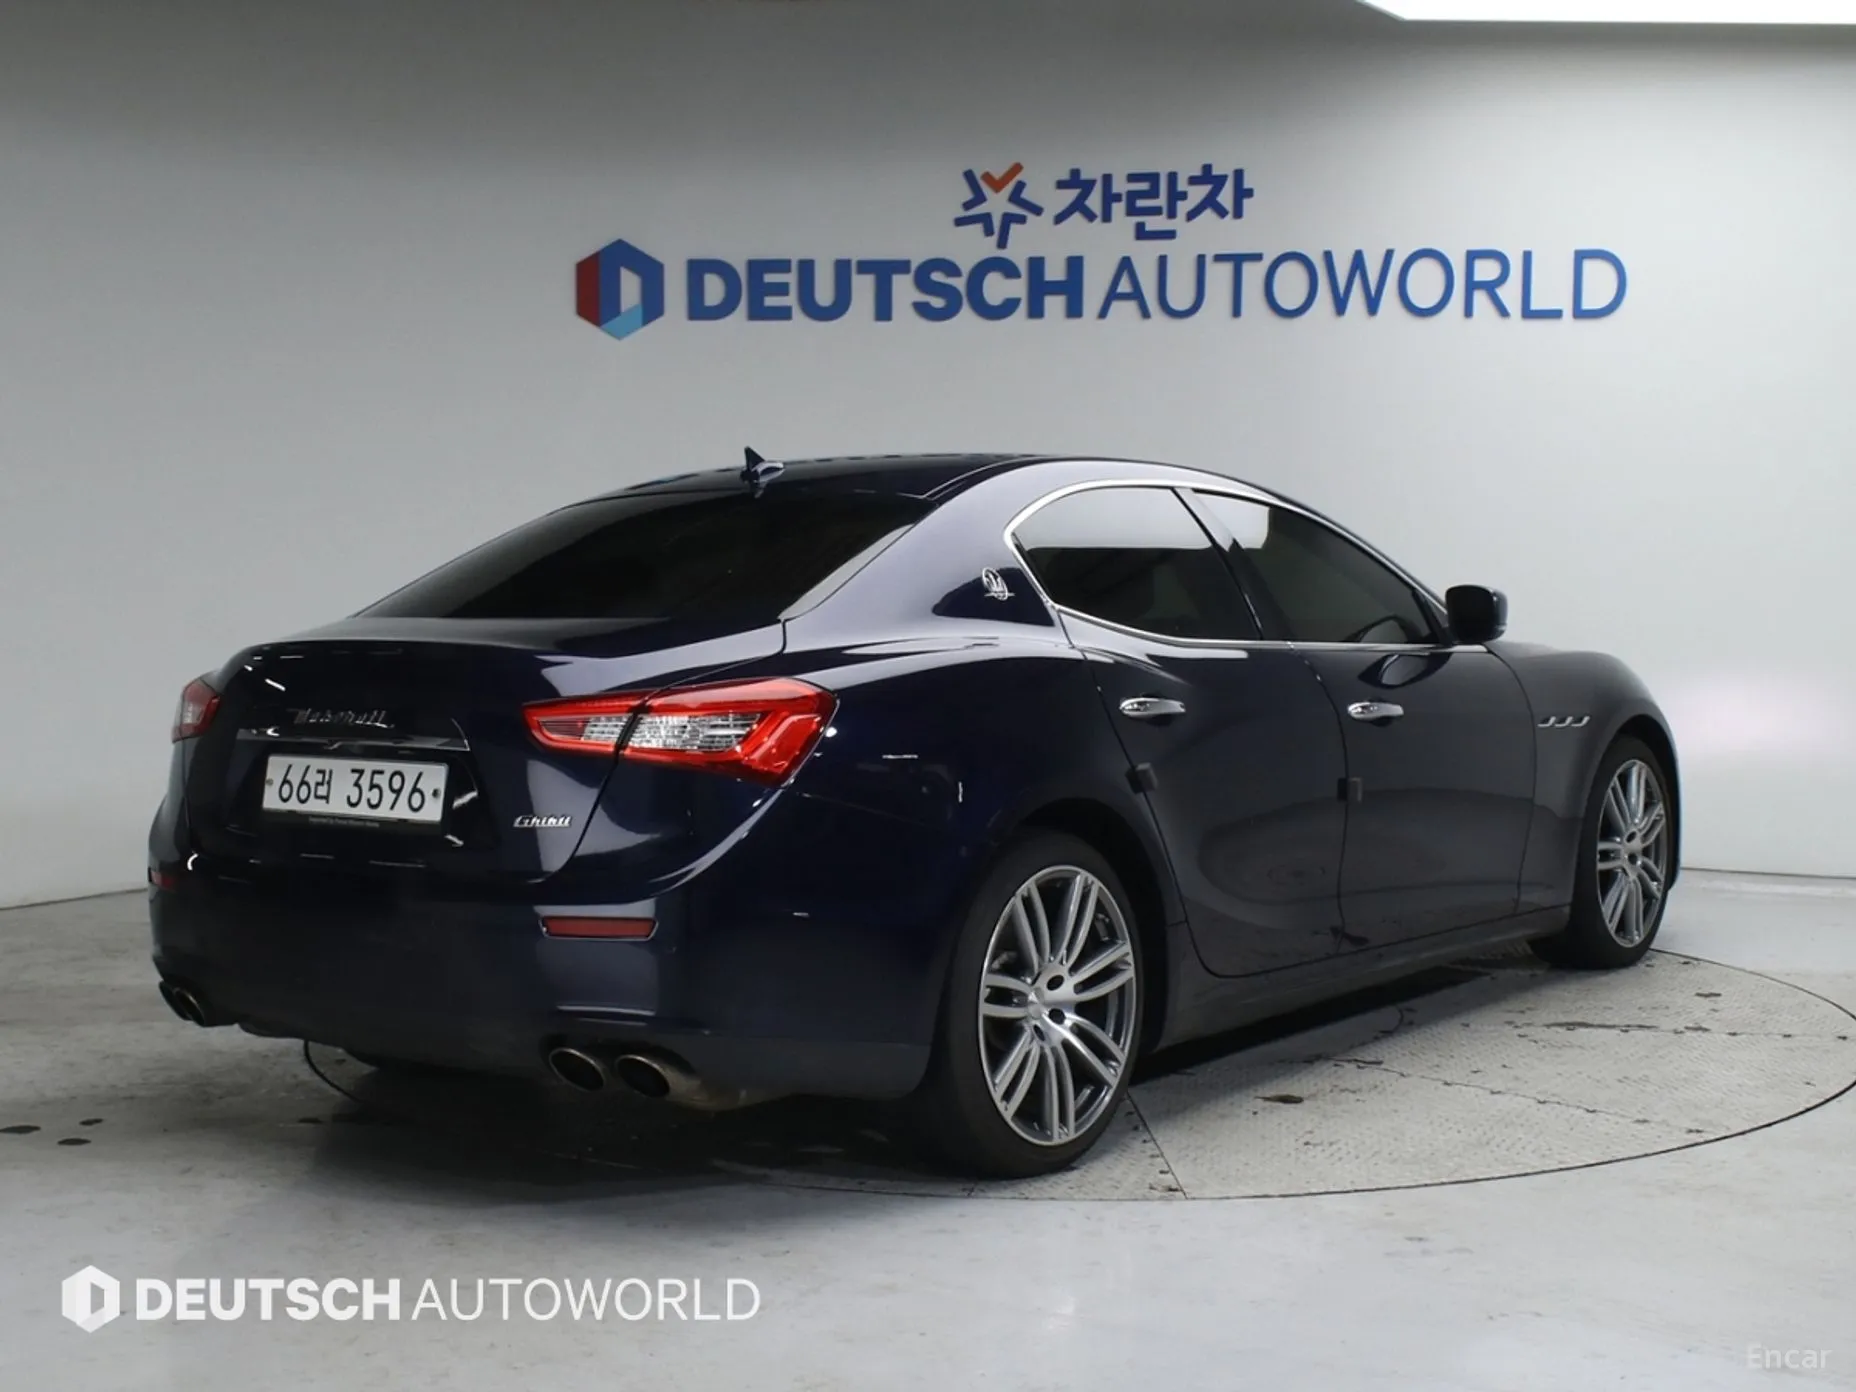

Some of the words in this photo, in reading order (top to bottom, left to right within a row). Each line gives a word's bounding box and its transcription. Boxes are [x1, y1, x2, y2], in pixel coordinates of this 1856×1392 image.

[1054, 164, 1254, 241] 차란차
[686, 255, 1084, 322] DEUTSCH
[1097, 248, 1628, 320] AUTOWORLD
[278, 764, 333, 804] 66러
[346, 768, 426, 813] 3596
